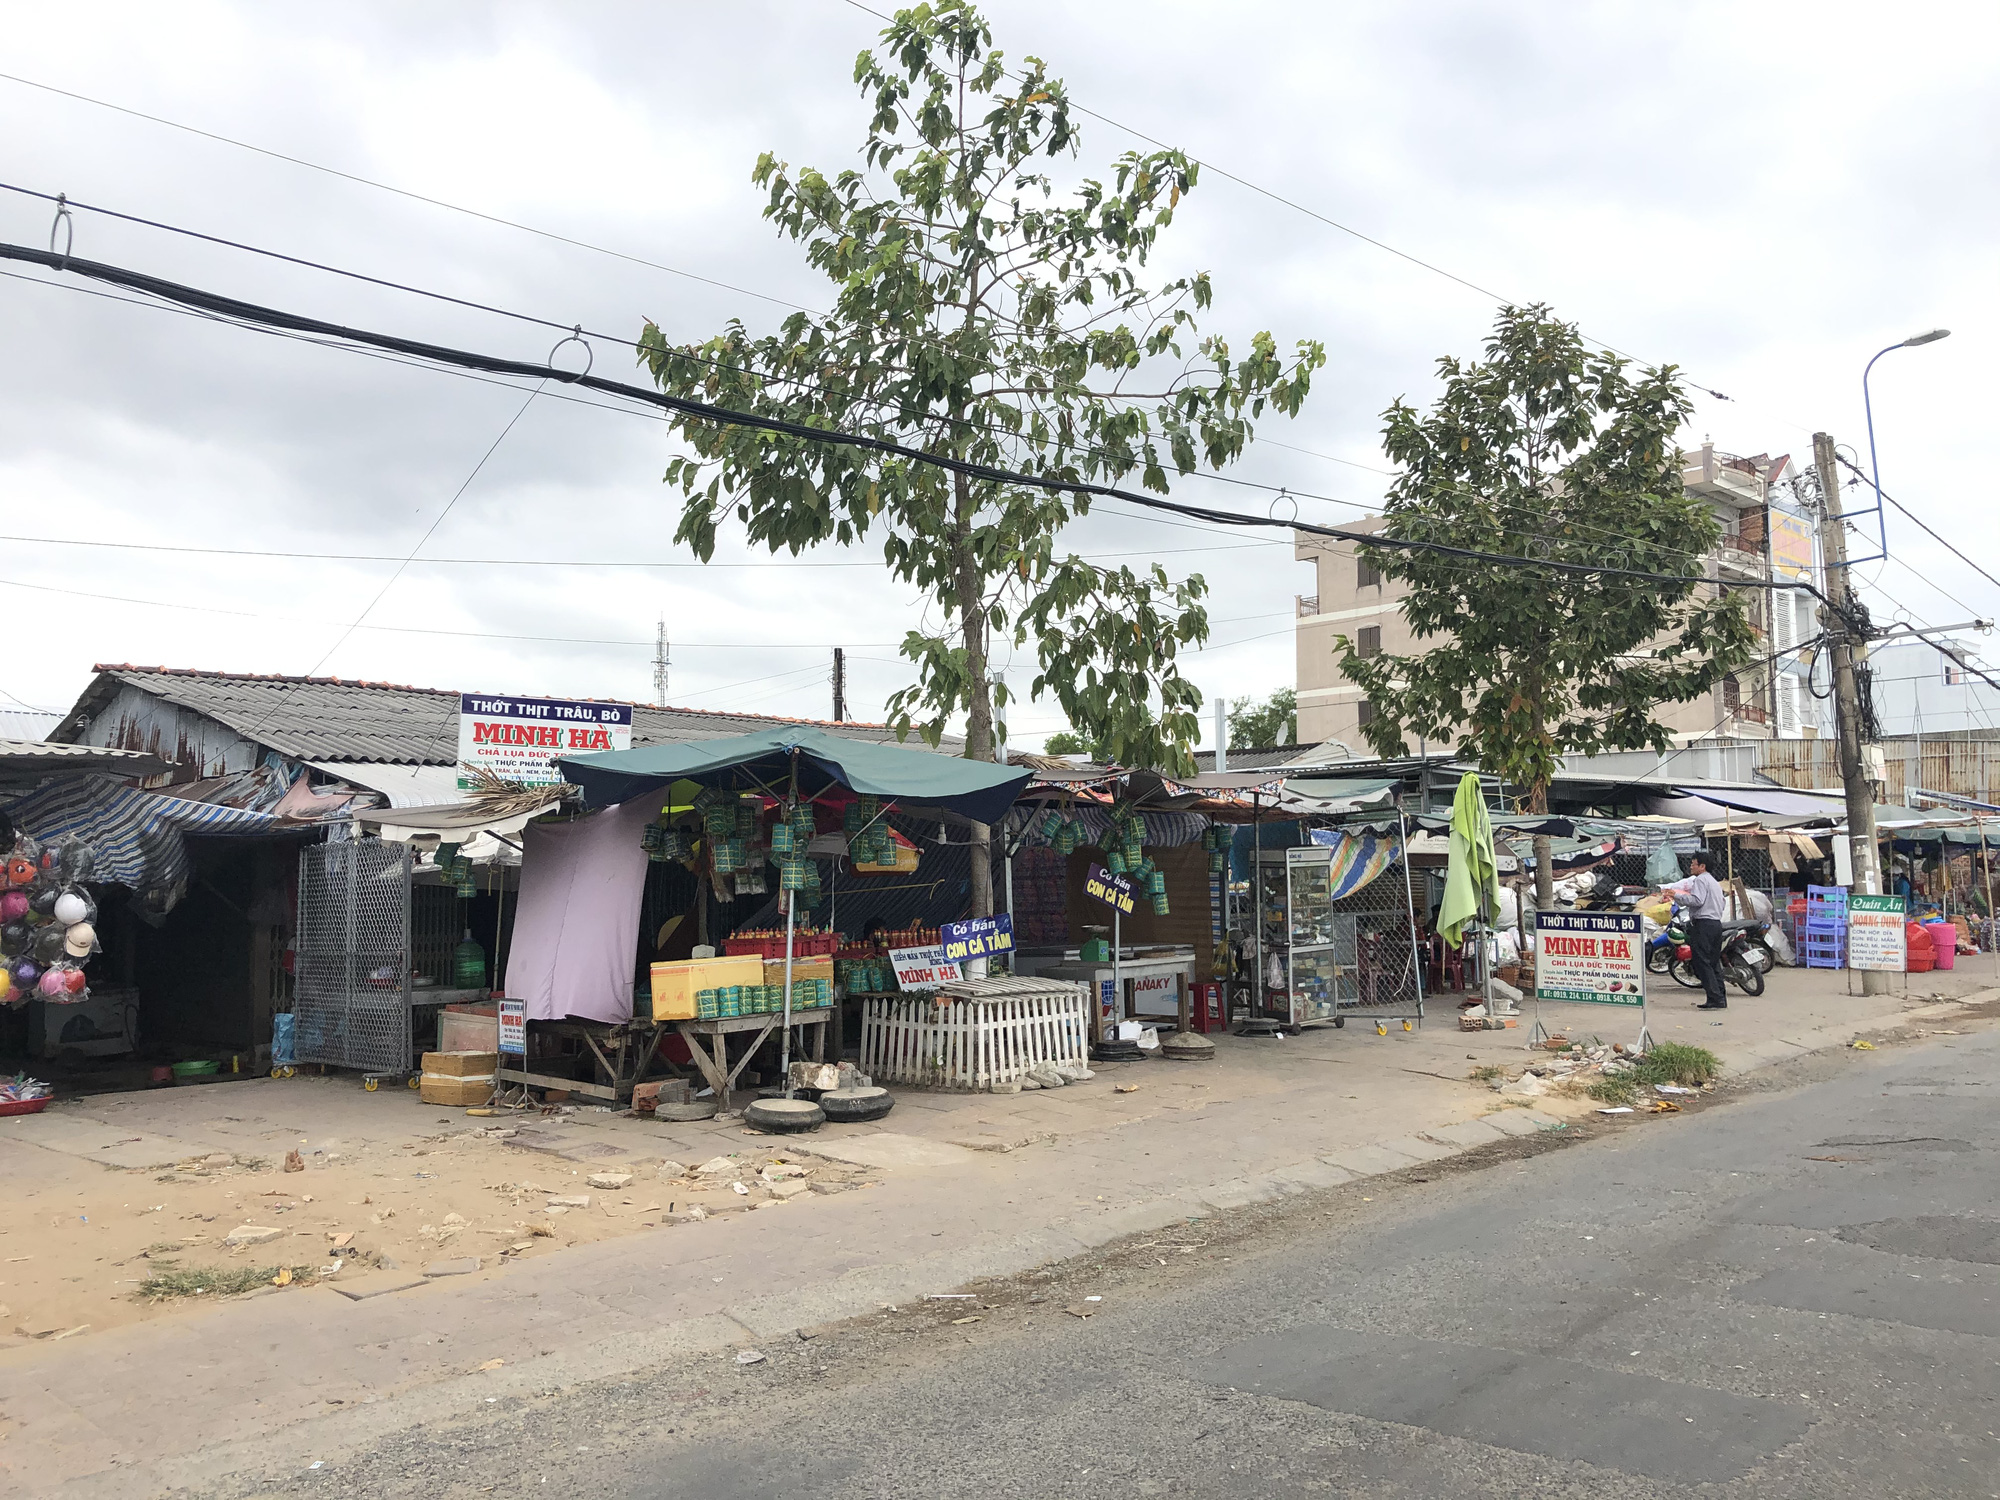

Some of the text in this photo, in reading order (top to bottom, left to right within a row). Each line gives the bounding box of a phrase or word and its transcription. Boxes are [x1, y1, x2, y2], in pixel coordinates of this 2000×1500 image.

[471, 699, 621, 722] THỚT THỊT TRÂU, BÒ
[473, 722, 615, 751] MINH HÀ
[477, 747, 500, 756] CHẢ
[503, 749, 525, 758] LỤA
[528, 749, 550, 759] ĐỨC
[495, 759, 517, 767] THỰC
[519, 758, 543, 768] PHẨM
[1113, 874, 1131, 891] bán
[1086, 878, 1106, 899] CON
[1105, 887, 1118, 905] CÁ
[1852, 897, 1903, 911] Quán Ăn
[952, 920, 996, 936] Có bán
[1542, 914, 1635, 931] THỚT THỊT TRÂU, BÒ
[946, 940, 968, 959] CON
[968, 934, 986, 955] CÁ
[1544, 934, 1633, 961] MINH HÀ
[1551, 959, 1631, 971] CHẢ LỤA ĐỨC TRỌNG
[1563, 969, 1580, 977] THỰC
[1582, 968, 1601, 978] PHẨM
[1621, 972, 1639, 981] LẠNH
[1134, 976, 1171, 992] ANAKY
[1569, 992, 1581, 1000] 214.
[1626, 996, 1637, 1004] 550
